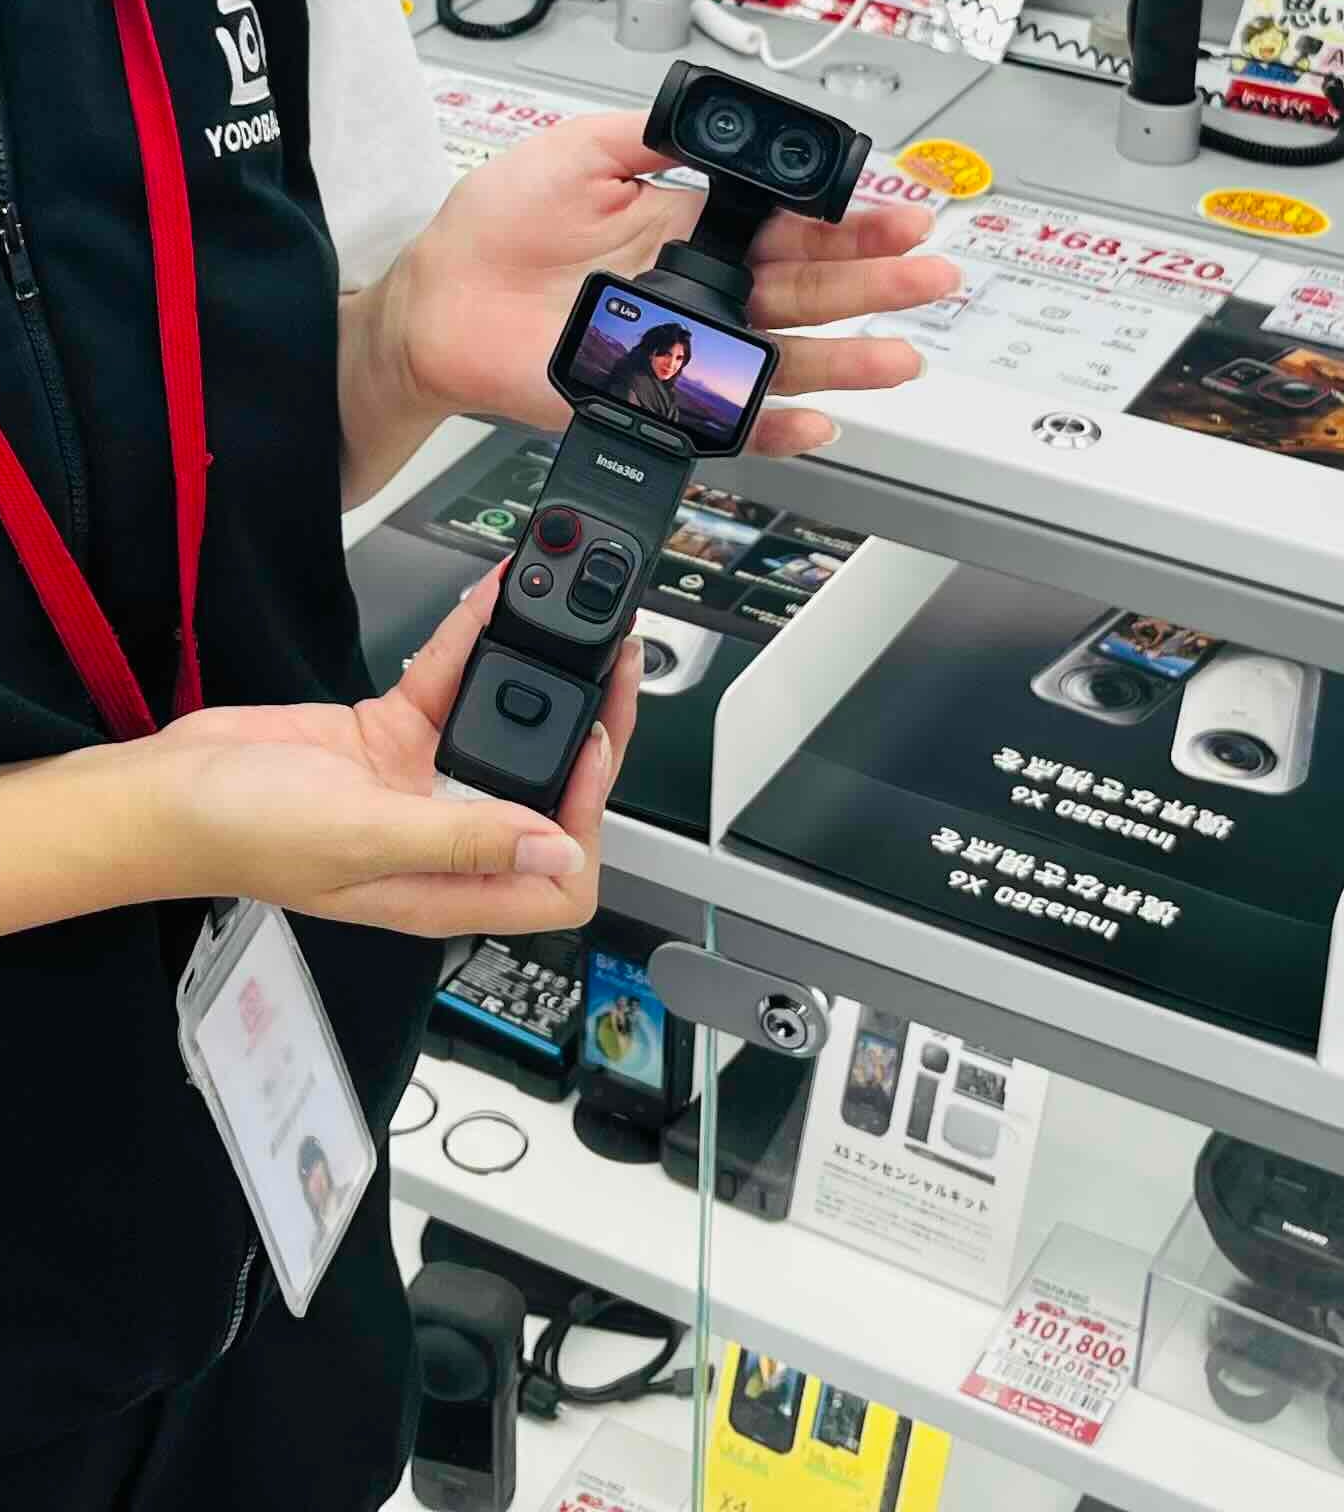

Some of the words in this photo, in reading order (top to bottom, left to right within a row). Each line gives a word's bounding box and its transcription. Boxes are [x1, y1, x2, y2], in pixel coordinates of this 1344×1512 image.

[205, 110, 280, 157] YODOBA
[1037, 223, 1225, 280] ¥68,720
[620, 305, 638, 319] Live
[595, 453, 645, 484] Insta360
[991, 745, 1238, 842] 境界なき視点を
[1009, 783, 1052, 811] X6
[1055, 796, 1178, 853] Insta360
[929, 825, 1184, 929] 境界なき視点を
[947, 868, 990, 898] X6
[994, 884, 1120, 942] Insta360
[1012, 1308, 1126, 1368] ¥101,800
